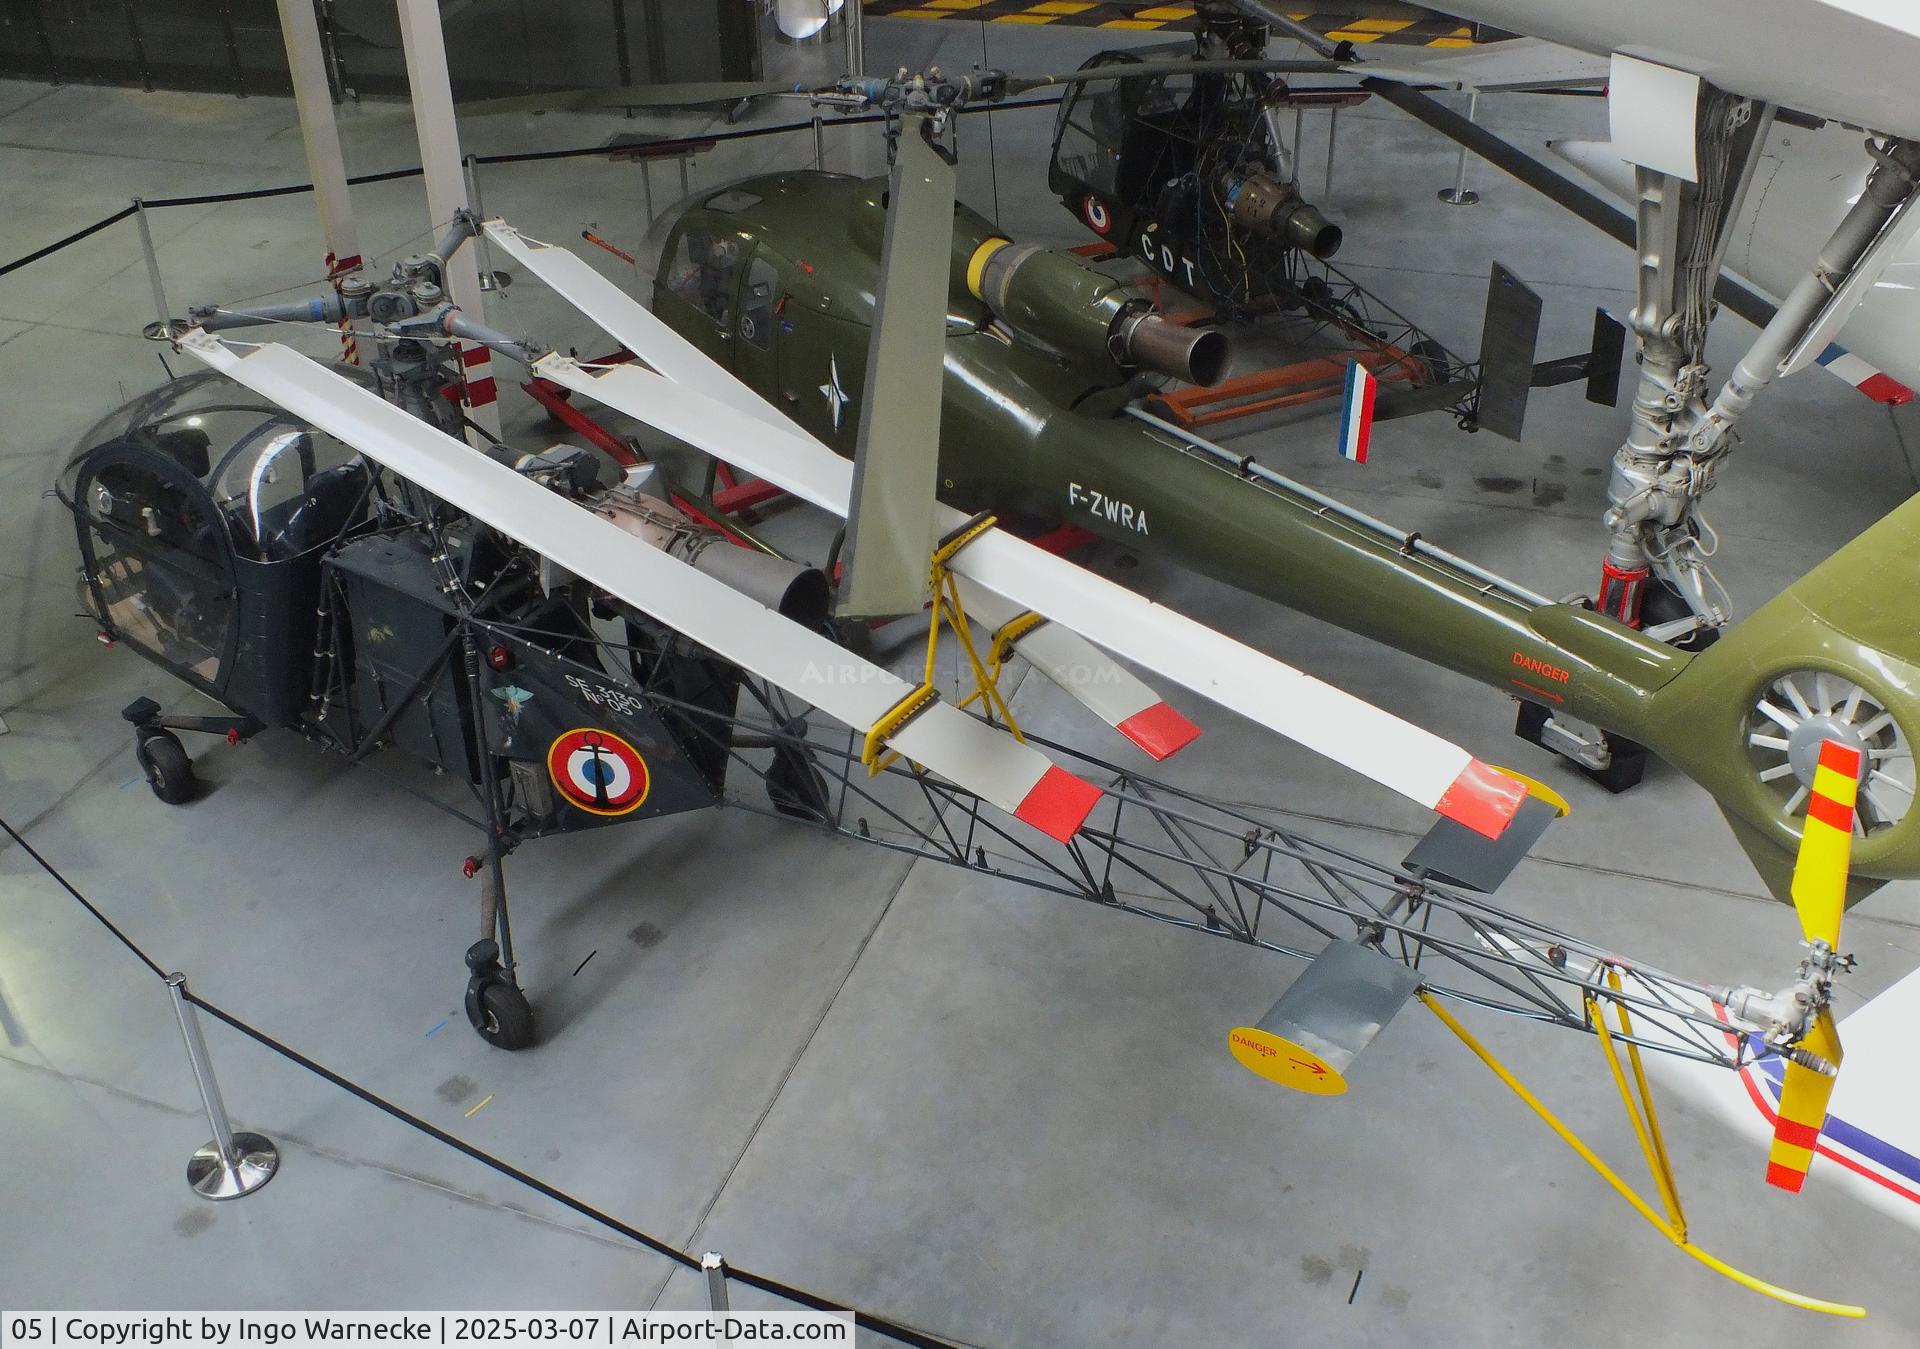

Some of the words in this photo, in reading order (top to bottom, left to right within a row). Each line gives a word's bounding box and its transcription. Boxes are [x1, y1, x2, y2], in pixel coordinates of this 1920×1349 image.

[1069, 482, 1149, 536] F-ZWRA
[1511, 651, 1569, 684] DANGER
[565, 674, 591, 692] SE
[595, 685, 642, 709] 3130
[606, 699, 633, 716] 05
[1232, 1034, 1278, 1057] DANGER
